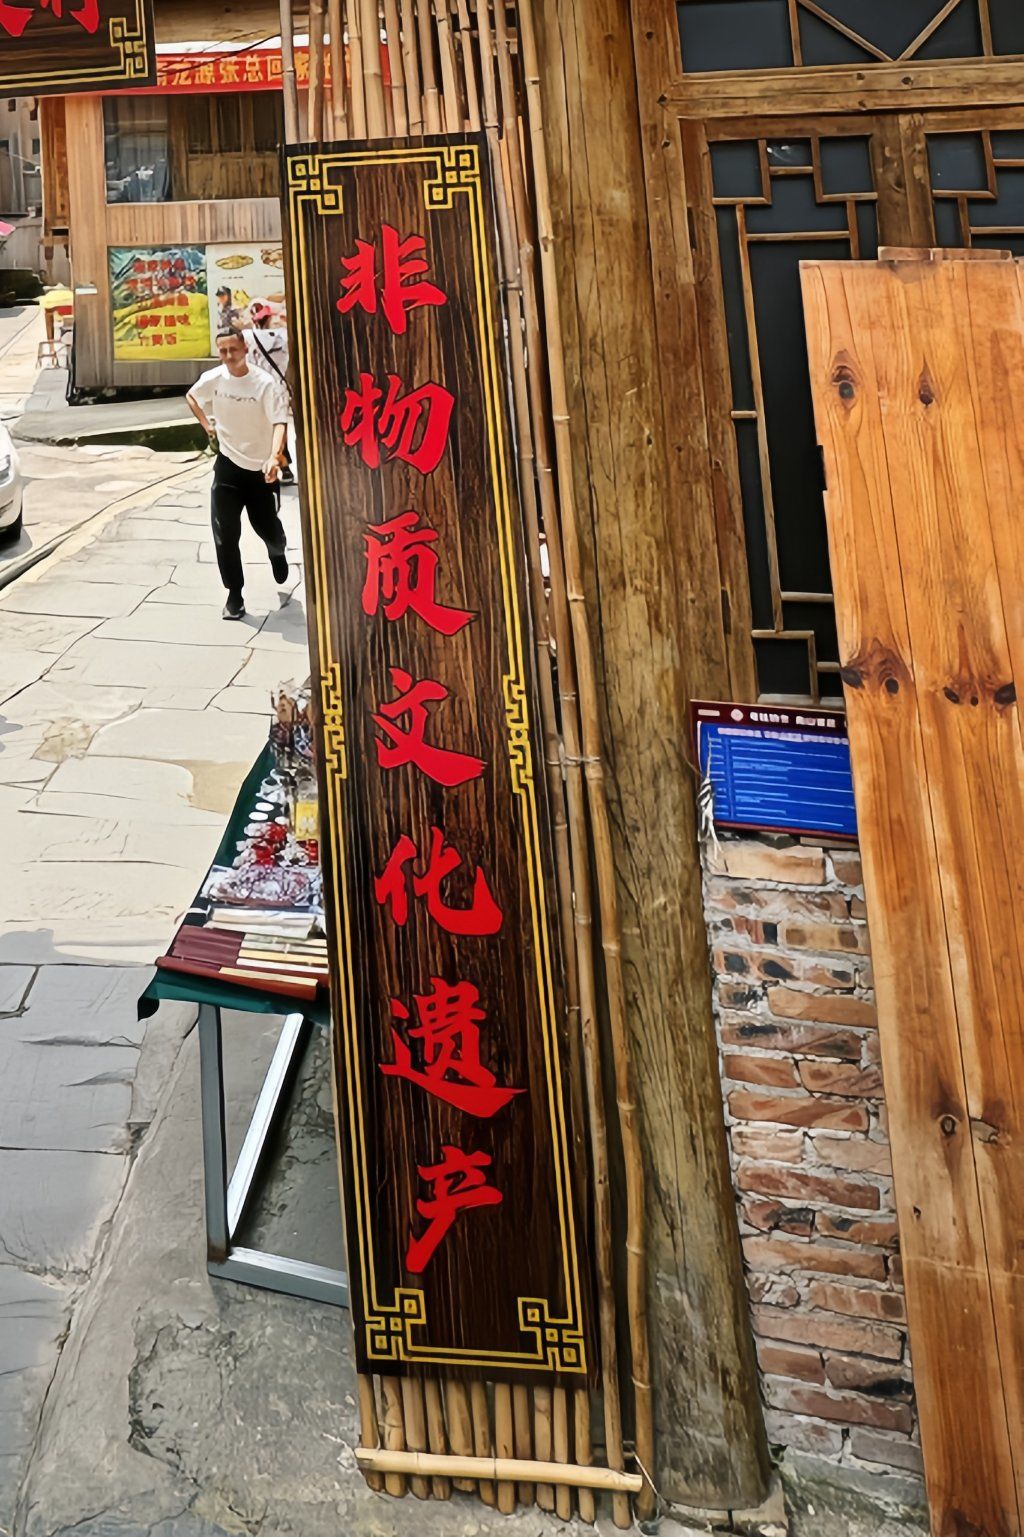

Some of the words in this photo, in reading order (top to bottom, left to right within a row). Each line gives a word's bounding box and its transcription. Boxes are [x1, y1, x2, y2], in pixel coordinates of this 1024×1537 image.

[335, 223, 526, 1273] 非物质文化遗产
